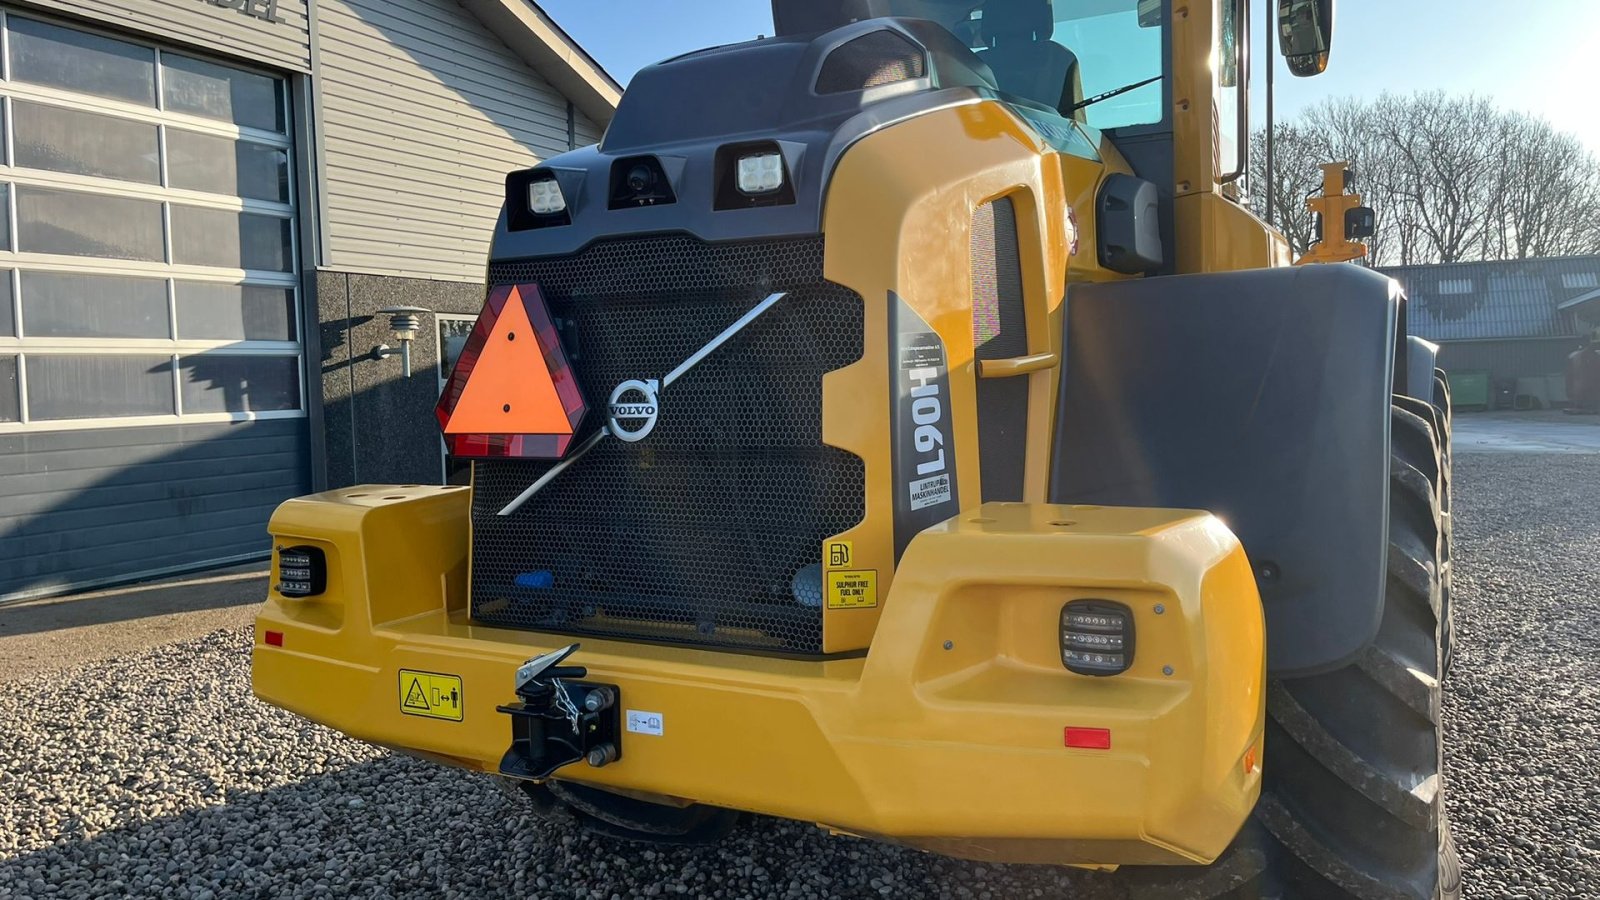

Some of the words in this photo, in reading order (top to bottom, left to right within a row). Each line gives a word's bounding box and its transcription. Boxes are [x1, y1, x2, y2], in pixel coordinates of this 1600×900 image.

[608, 406, 656, 415] VOLVO
[909, 367, 945, 475] L90H
[912, 485, 949, 501] MASKINHANDEL
[836, 581, 857, 589] SULPHUR
[857, 580, 869, 588] FREE
[852, 588, 864, 596] ONLY
